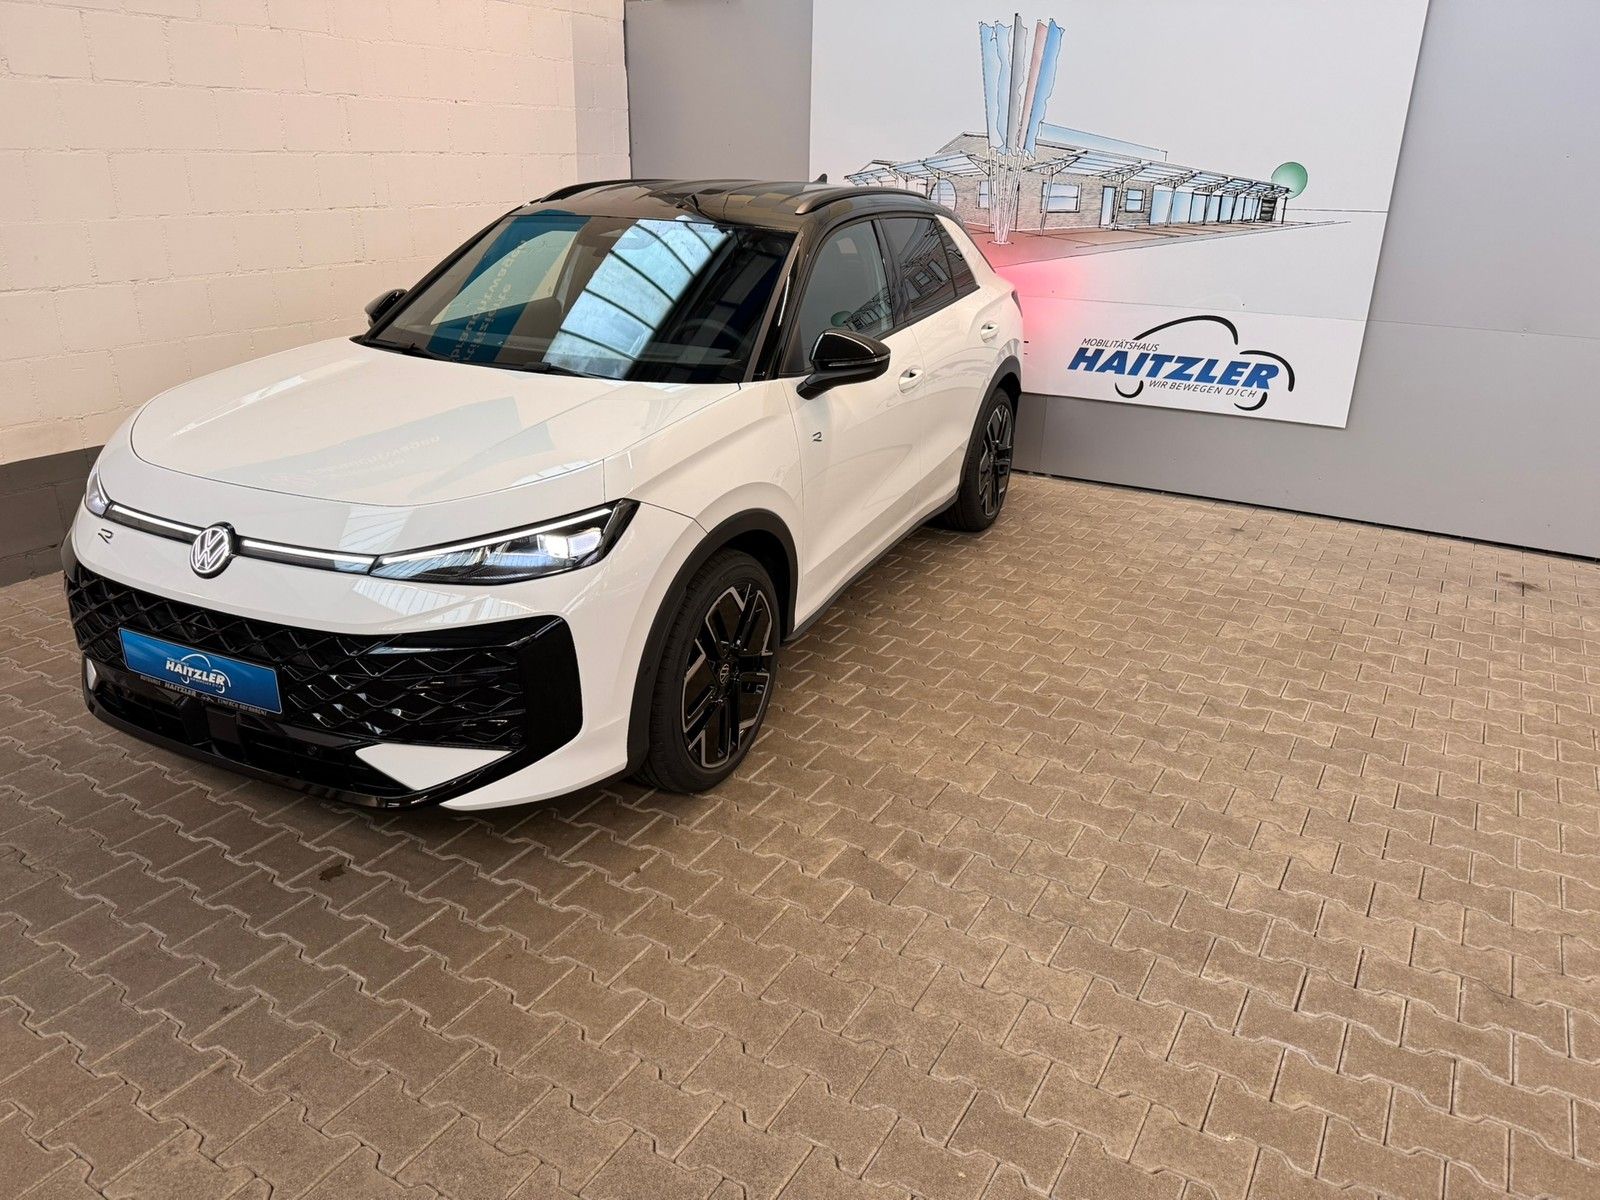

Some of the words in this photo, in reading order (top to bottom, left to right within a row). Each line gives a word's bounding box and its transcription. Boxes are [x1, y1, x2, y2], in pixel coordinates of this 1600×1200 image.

[1081, 338, 1159, 352] MOBILITÄTSHAUS
[1067, 347, 1279, 389] HAITZLER
[1149, 380, 1168, 389] WIR
[1169, 382, 1223, 395] BEWEGEN
[1226, 388, 1258, 398] DICH
[166, 660, 226, 686] HAITZLER
[165, 682, 197, 698] HAITZLER
